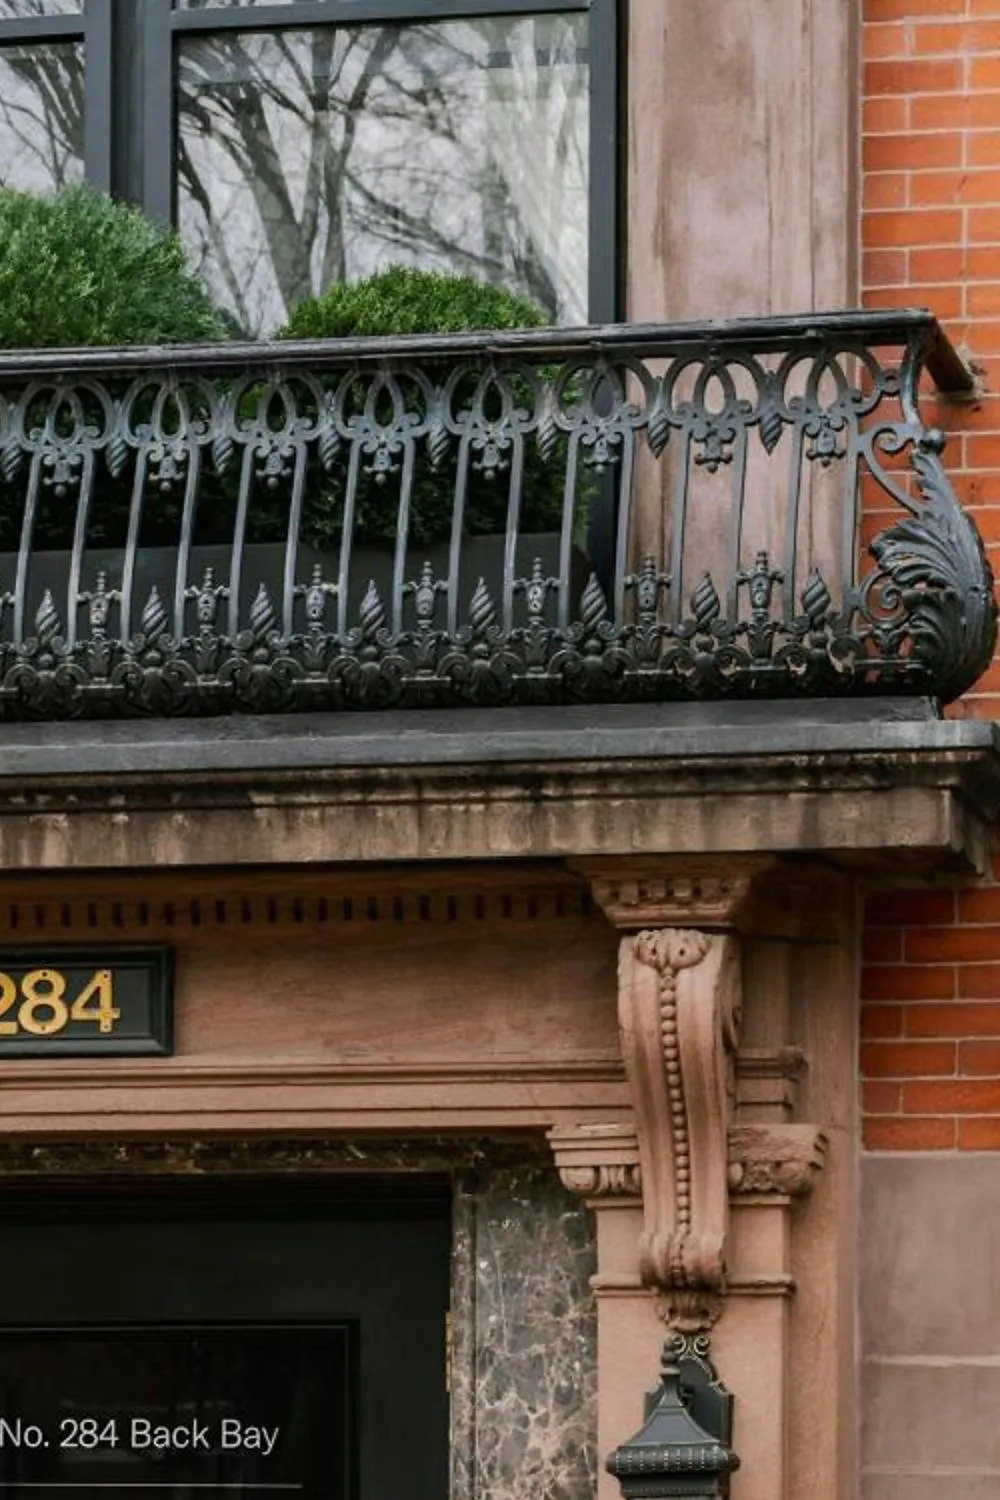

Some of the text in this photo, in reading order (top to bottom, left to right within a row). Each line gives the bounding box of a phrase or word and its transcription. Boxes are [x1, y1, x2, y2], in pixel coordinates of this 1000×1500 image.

[0, 1417, 279, 1456] No. 284 Back Bay
